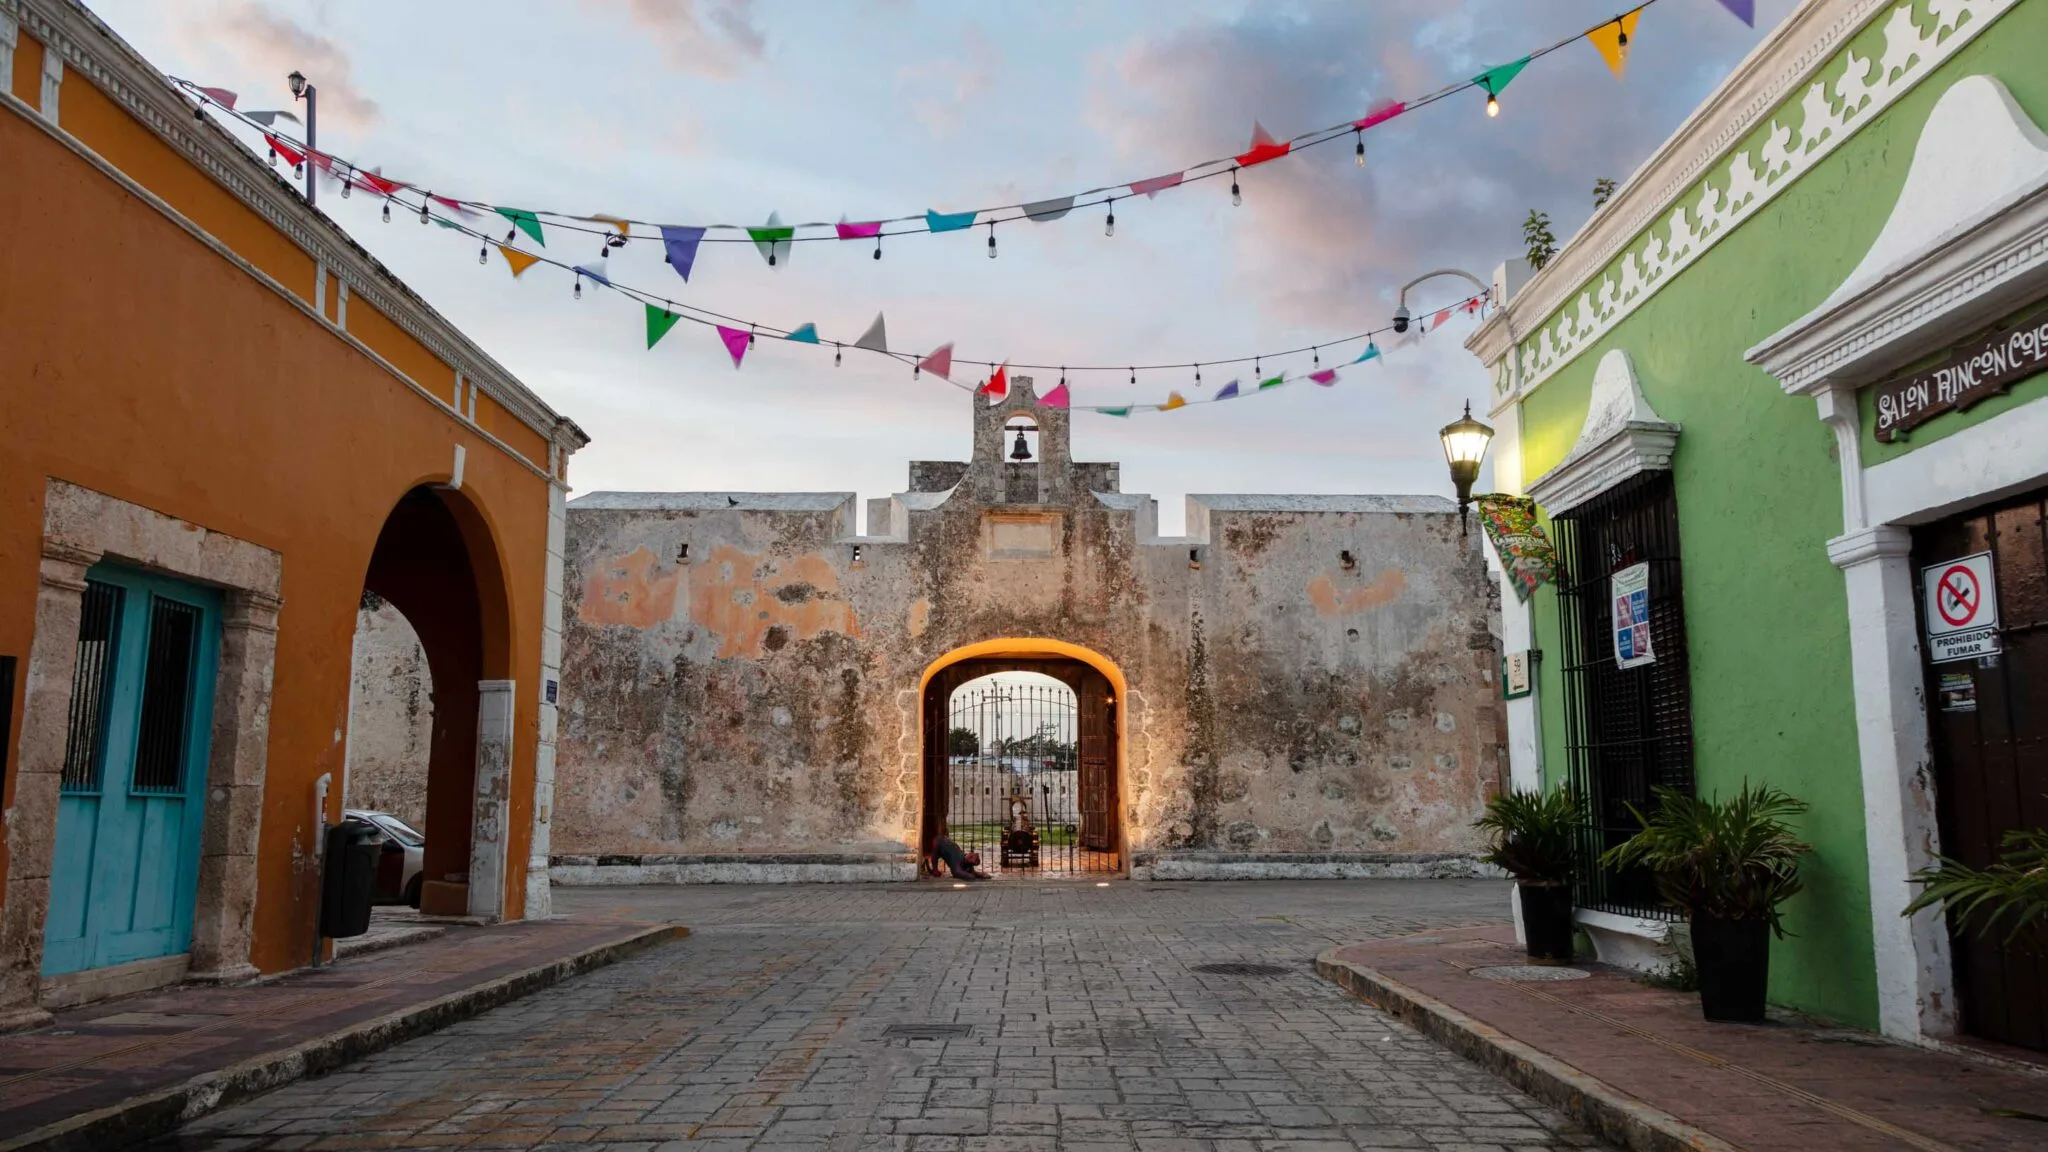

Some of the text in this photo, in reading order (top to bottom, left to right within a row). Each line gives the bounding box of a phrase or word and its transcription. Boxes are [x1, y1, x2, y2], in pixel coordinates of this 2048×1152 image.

[1878, 378, 1929, 429] SALÓN
[1932, 343, 2007, 404] RINCÓN
[1936, 631, 1991, 648] PROHIBIDO
[1947, 644, 1982, 656] FUMAR
